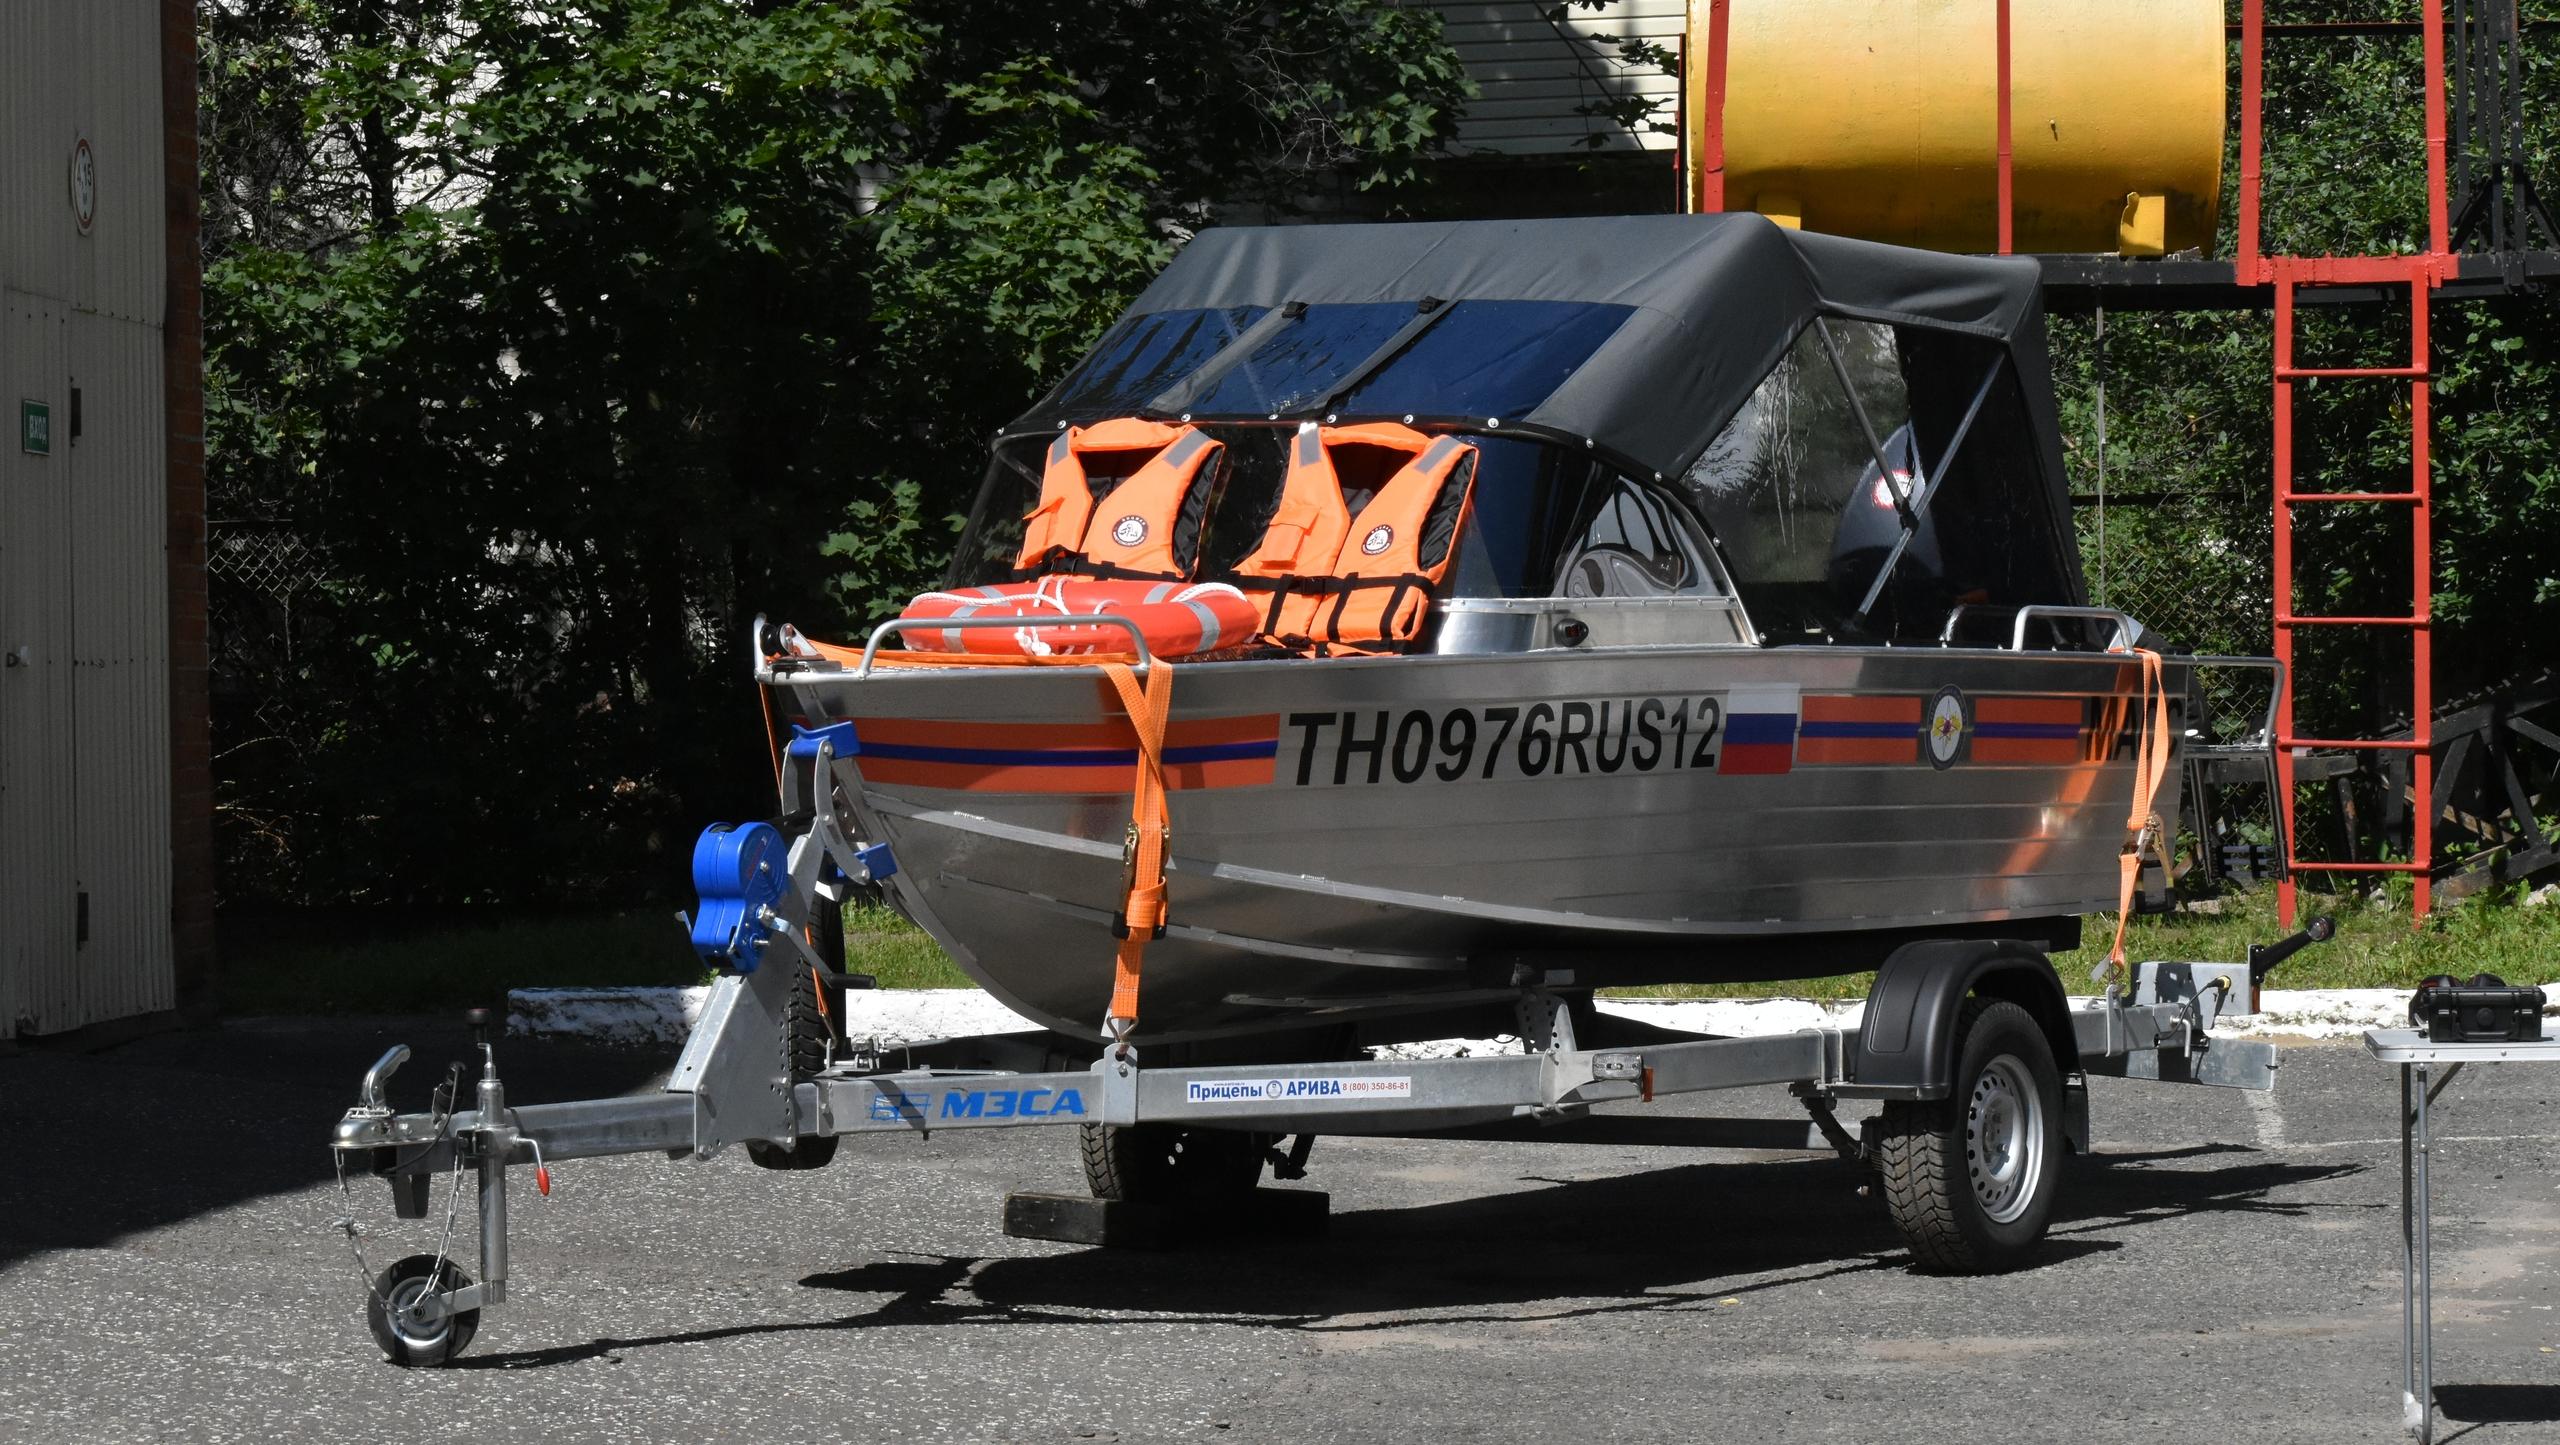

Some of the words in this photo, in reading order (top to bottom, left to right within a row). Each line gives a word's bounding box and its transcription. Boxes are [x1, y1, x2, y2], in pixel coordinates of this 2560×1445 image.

[940, 1088, 1086, 1119] МЗСА
[1189, 1083, 1262, 1101] Прицепы
[1286, 1080, 1341, 1096] АРИВА
[1342, 1082, 1348, 1091] 8
[1349, 1082, 1369, 1093] (800)
[1371, 1081, 1409, 1091] 350-86-81
